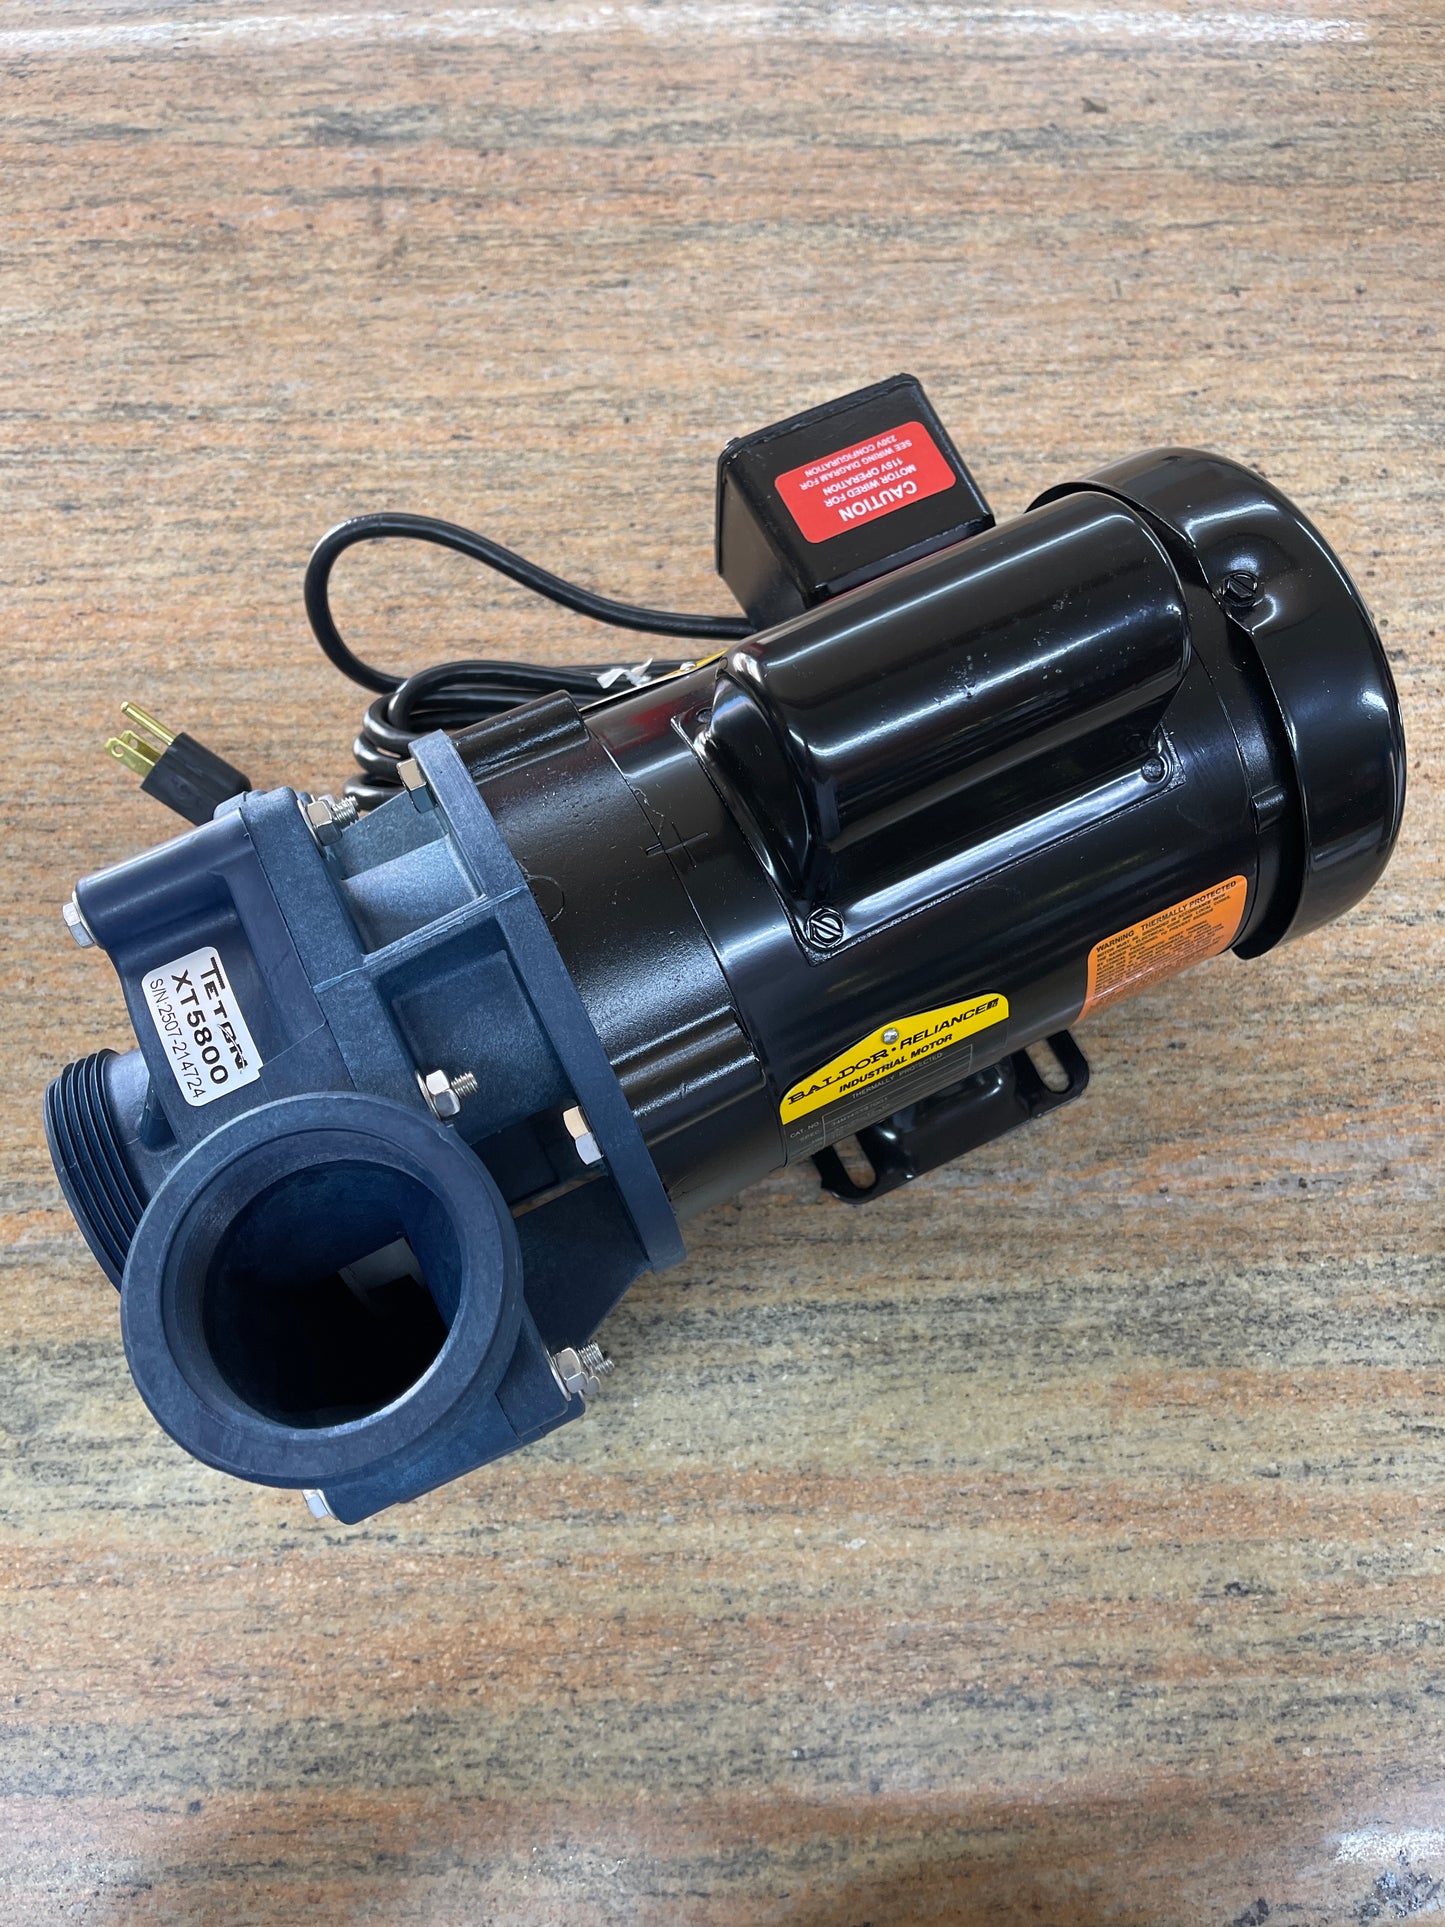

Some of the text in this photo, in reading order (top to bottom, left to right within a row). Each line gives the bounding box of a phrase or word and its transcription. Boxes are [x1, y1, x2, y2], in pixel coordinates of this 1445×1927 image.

[798, 439, 912, 490] SEE WIRING DIAGRAM FOR
[804, 434, 897, 476] 230V CONFIGURATION
[822, 456, 903, 495] 115V OPERATION
[823, 463, 916, 507] MOTOR WIRED FOR
[837, 480, 917, 522] CAUTION
[1097, 930, 1134, 952] WARNING
[1141, 904, 1187, 931] THERMALLY
[1189, 881, 1237, 907] PROTECTED
[148, 977, 206, 1099] S/N:2507-214724
[170, 968, 229, 1085] XT5800
[787, 1002, 989, 1105] BALDOR RELIANCE
[839, 1033, 952, 1092] INDUSTRIAL MOTOR
[851, 1051, 942, 1100] THERMALLY PROTECTED
